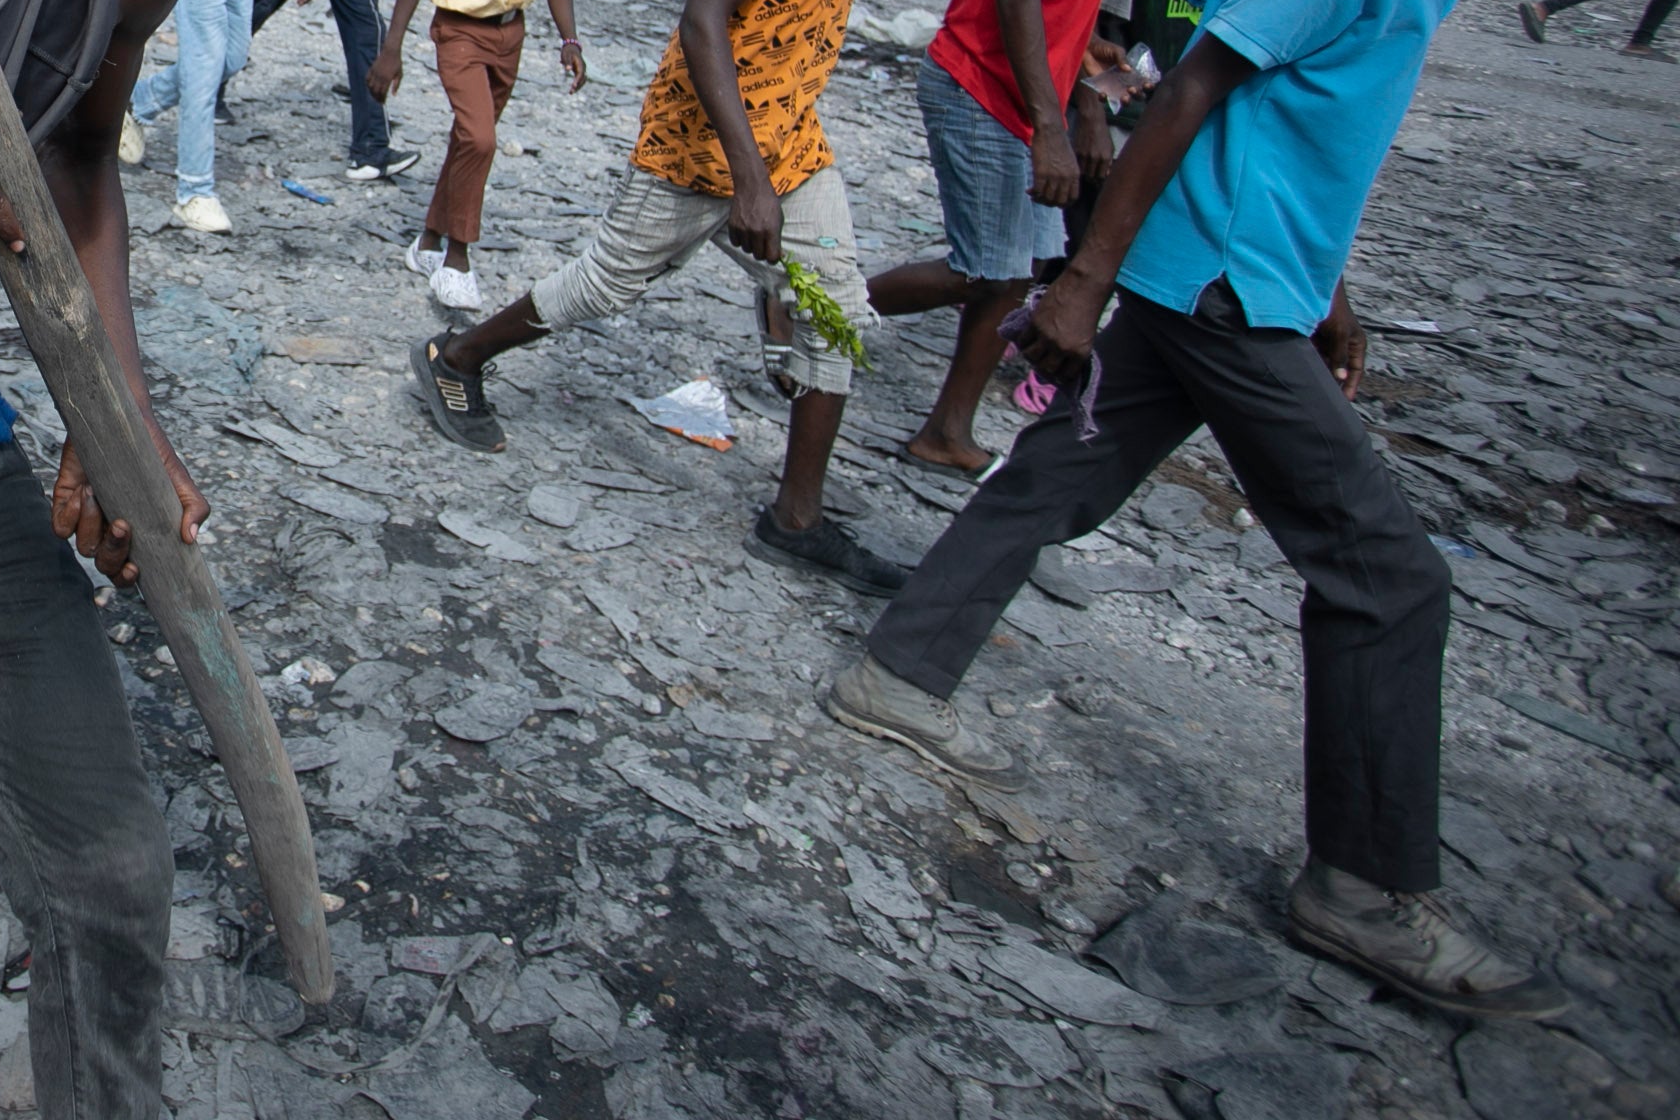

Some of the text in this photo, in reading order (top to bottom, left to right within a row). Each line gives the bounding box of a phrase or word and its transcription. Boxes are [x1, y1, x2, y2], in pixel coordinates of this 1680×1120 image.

[755, 2, 800, 22] adidas
[741, 77, 785, 93] adidas
[642, 146, 678, 157] adidas
